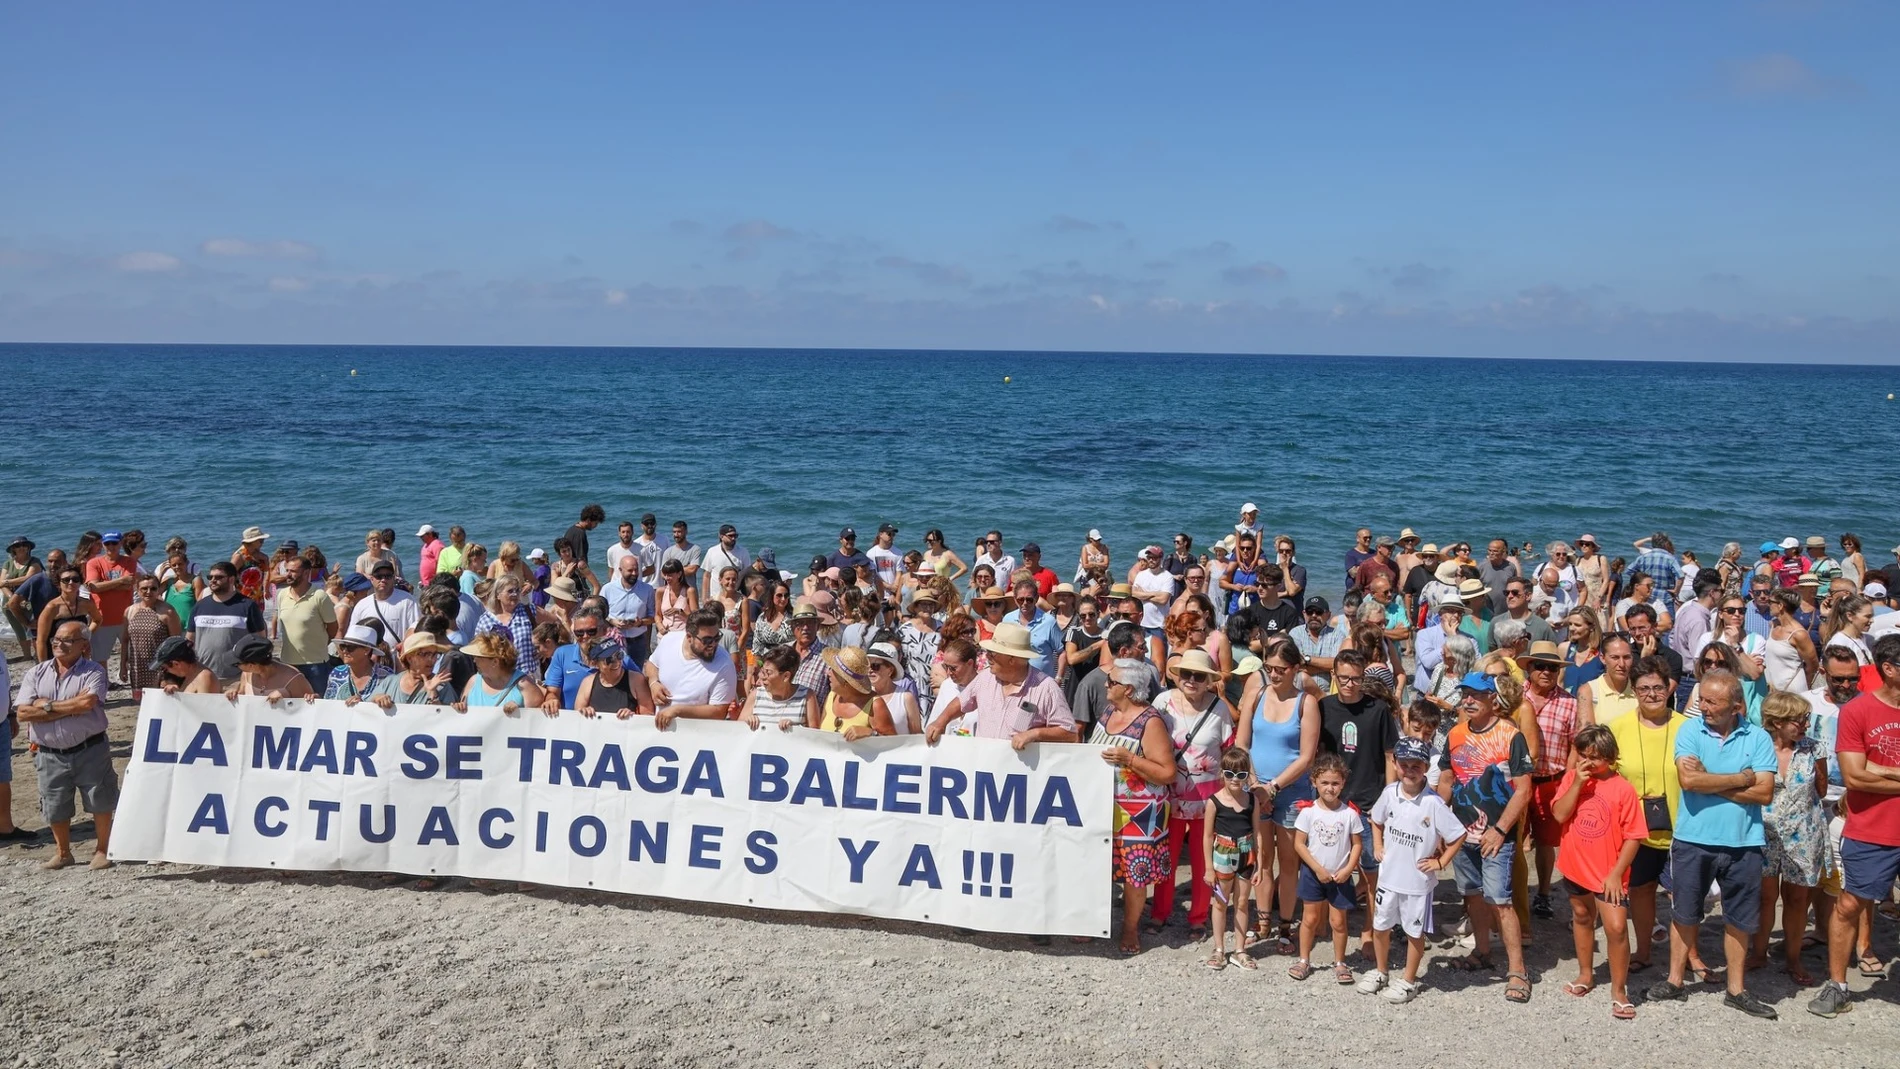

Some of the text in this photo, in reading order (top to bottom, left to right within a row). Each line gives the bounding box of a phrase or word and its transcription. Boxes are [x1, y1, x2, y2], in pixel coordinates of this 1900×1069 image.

[201, 617, 231, 625] Kappa
[1868, 725, 1884, 738] LEVI
[143, 718, 1083, 825] LA MAR SE TRAGA BALERMA
[1389, 826, 1424, 843] Emirates
